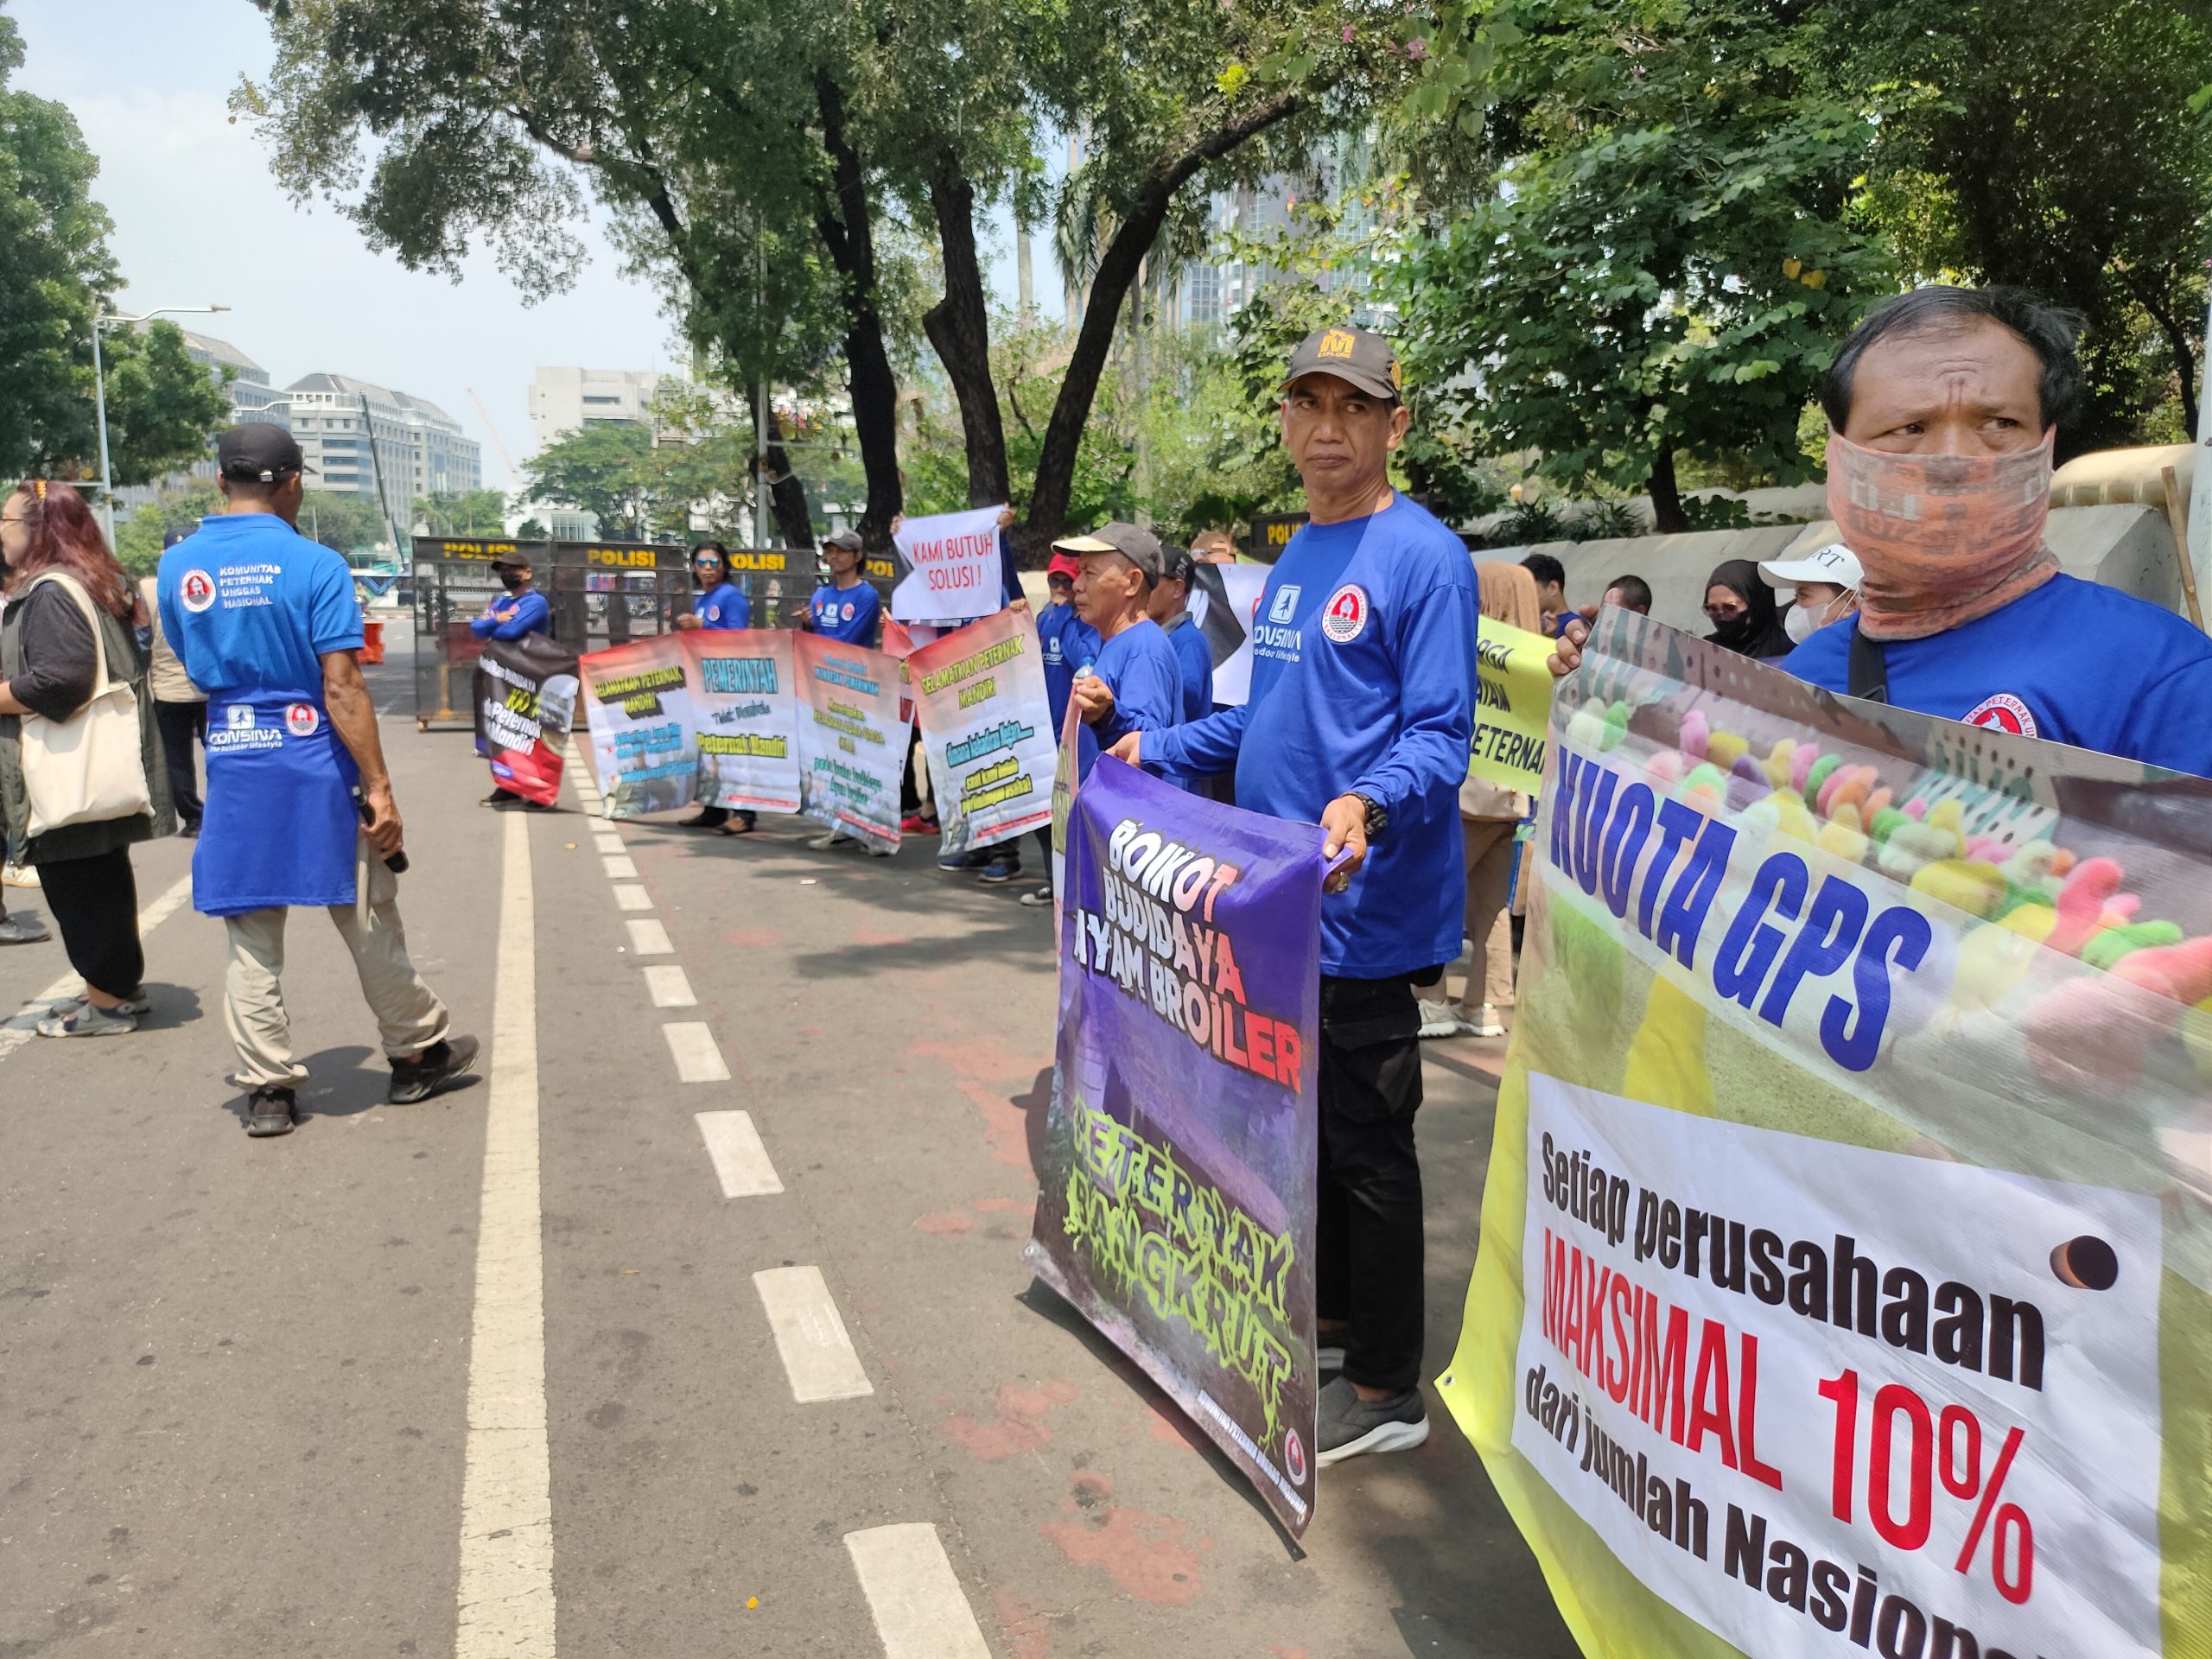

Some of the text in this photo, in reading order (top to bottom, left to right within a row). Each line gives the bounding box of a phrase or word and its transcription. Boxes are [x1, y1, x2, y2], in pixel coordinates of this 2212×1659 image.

[1317, 351, 1351, 359] EXPLORE
[588, 550, 656, 568] POLISI
[729, 553, 785, 570] OLISI
[912, 531, 993, 563] KAMI BUTUH
[219, 563, 281, 576] KOMUNITAS
[219, 575, 273, 587] PETERNAK
[928, 565, 975, 591] SOLUSI
[221, 586, 261, 597] UNGGAS
[225, 595, 273, 608] NASIONAL
[594, 664, 683, 698] SELAMATKAN PETERNAK
[701, 658, 779, 695] PEMERINTAH
[921, 654, 979, 696] SELAMATKAN
[978, 634, 1026, 672] PETERNAK
[505, 686, 531, 714] 100
[958, 677, 997, 711] MANDIRI
[1986, 696, 2031, 726] PETERNAK
[209, 728, 283, 745] CONSINA
[249, 741, 283, 750] lifestyle
[696, 732, 750, 755] Peternak
[749, 734, 788, 760] Mandiri
[1470, 722, 1545, 774] ETERNA
[1109, 819, 1239, 923] BOIKOT
[1550, 743, 1932, 1072] KUOTA GPS
[1102, 866, 1246, 1006] BUDIDAYA
[1073, 908, 1301, 1094] AYAM BROILER
[1072, 1094, 1294, 1322] PETERNAK
[1542, 1131, 2044, 1393] Setiap perusahaan
[1063, 1162, 1291, 1426] BANGKRUT
[1542, 1226, 2035, 1605] MAKSIMAL 10%
[1526, 1363, 2046, 1659] dari jumlah Nasion
